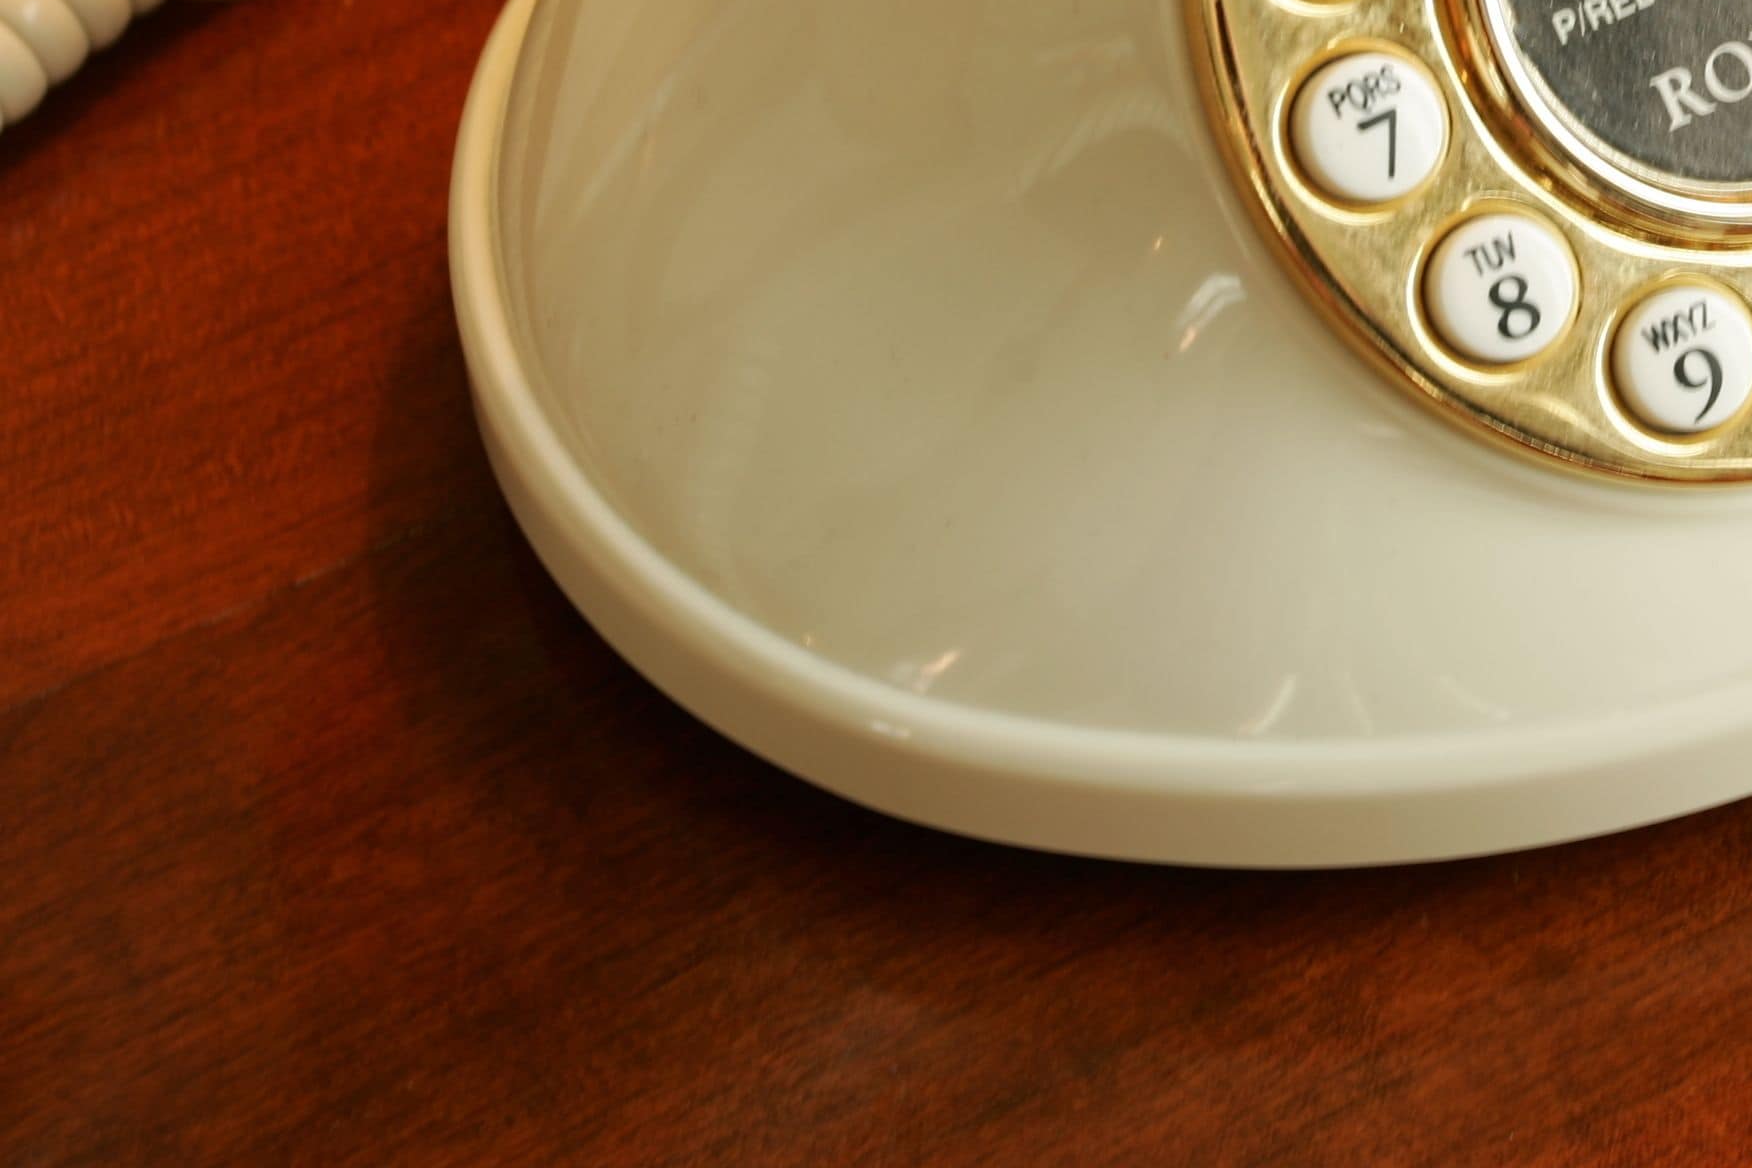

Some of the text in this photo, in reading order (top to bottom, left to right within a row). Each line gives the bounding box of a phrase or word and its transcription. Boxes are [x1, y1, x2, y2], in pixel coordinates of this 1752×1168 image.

[1327, 64, 1401, 119] PQRS
[1357, 107, 1397, 180] 7
[1463, 230, 1517, 277] TUV
[1488, 274, 1541, 340] 8
[1641, 298, 1717, 354] WXYZ
[1673, 347, 1723, 425] 9
